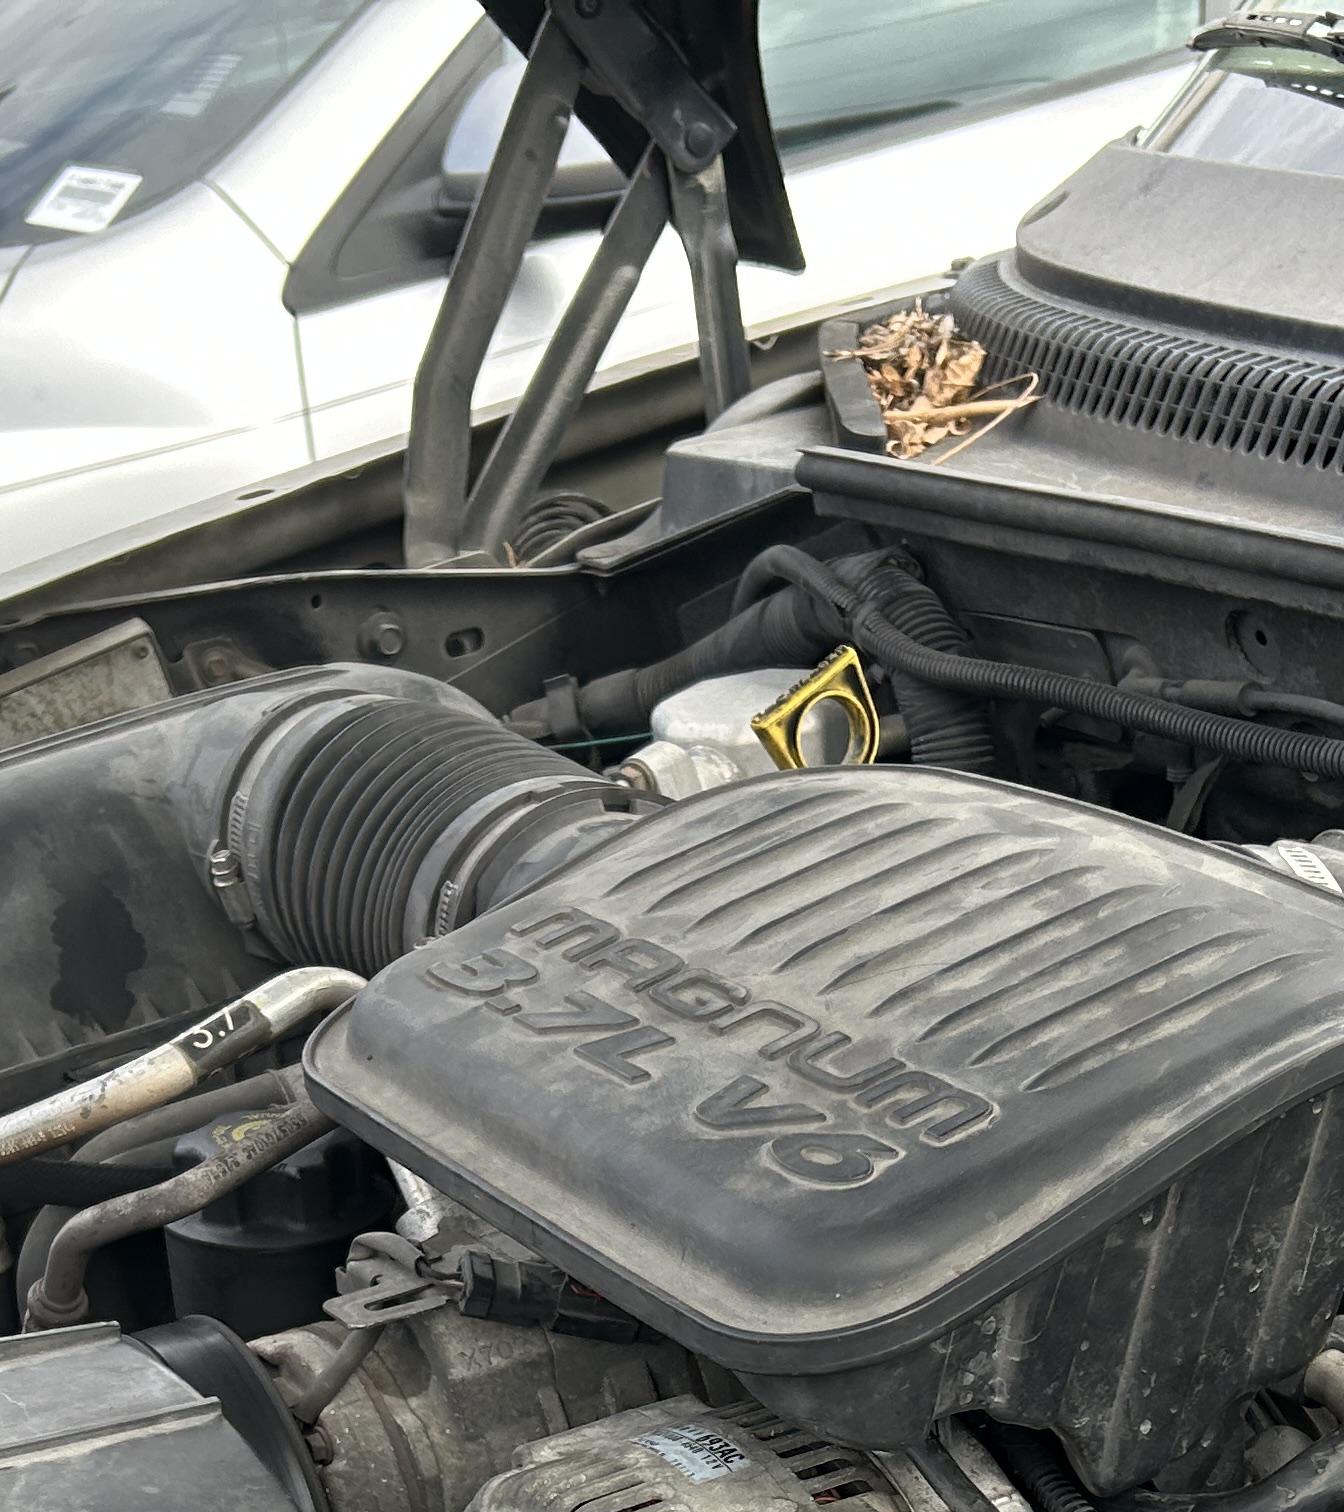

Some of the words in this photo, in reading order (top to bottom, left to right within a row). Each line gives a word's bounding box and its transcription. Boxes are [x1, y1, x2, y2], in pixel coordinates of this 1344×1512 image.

[425, 947, 675, 1085] 3.7L
[694, 1073, 906, 1190] V6
[511, 906, 999, 1145] MAGNUM
